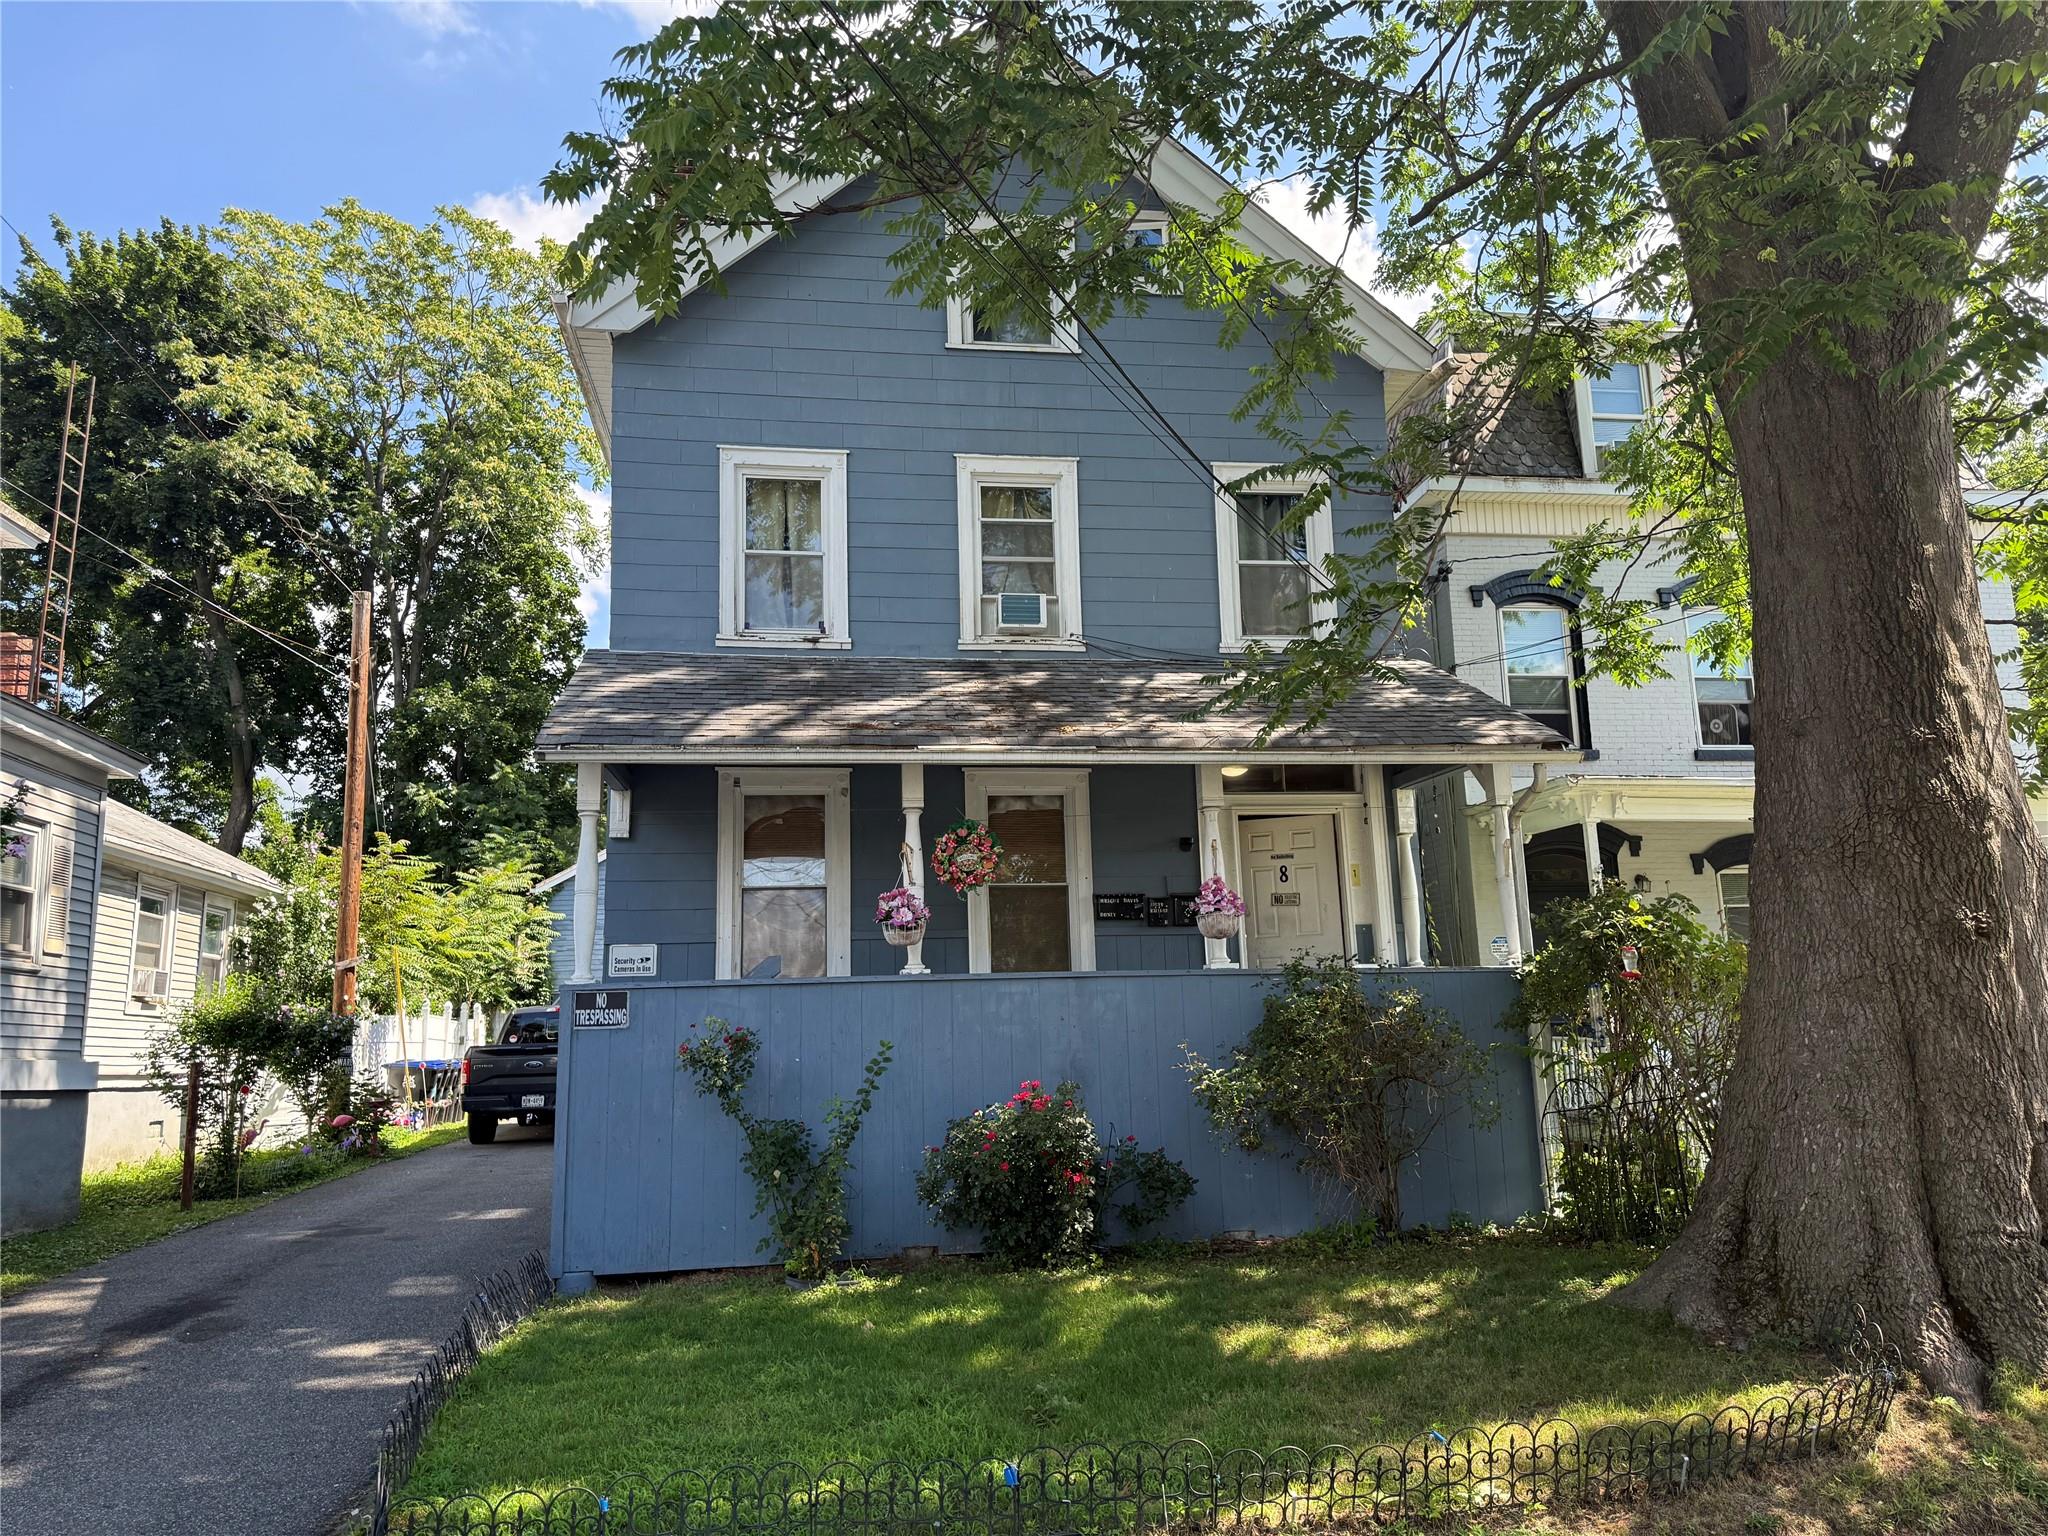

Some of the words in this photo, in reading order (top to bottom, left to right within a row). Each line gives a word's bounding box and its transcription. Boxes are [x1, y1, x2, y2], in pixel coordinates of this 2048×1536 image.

[1279, 865, 1289, 883] 8
[1274, 895, 1283, 904] NO
[614, 957, 636, 965] Security
[596, 993, 607, 1008] NO
[575, 1008, 627, 1025] TRESPASSING
